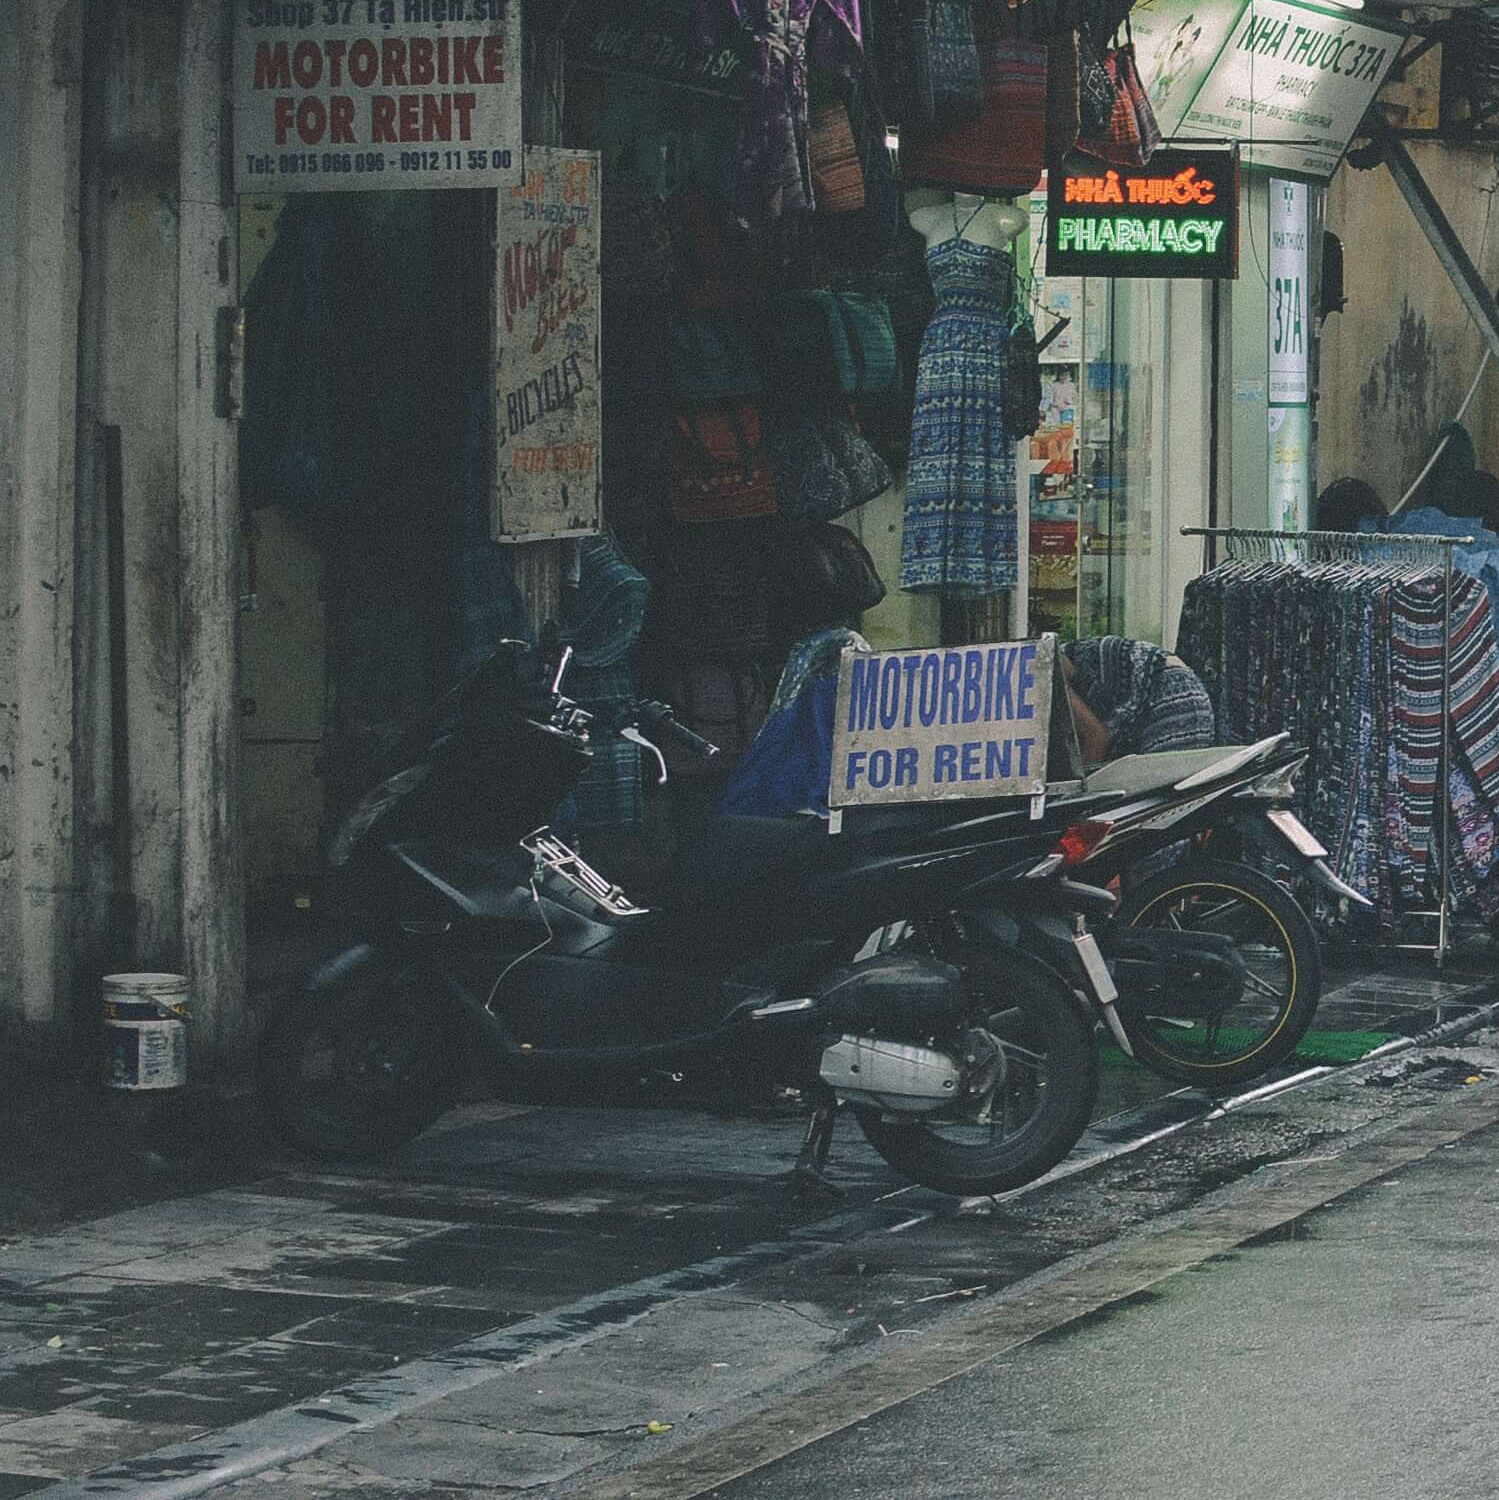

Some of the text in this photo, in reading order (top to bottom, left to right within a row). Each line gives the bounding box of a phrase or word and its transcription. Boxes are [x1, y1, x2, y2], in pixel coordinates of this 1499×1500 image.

[247, 0, 314, 29] Shop
[253, 35, 505, 90] MOTORBIKE
[1235, 12, 1387, 83] NHÀ THUỐC 37A
[275, 92, 477, 145] FOR RENT
[246, 153, 276, 175] Tel:
[279, 153, 318, 173] 0915
[322, 153, 351, 172] 066
[354, 152, 385, 171] 096
[401, 151, 439, 171] 0912
[445, 150, 462, 170] 11
[467, 150, 487, 169] 55
[491, 149, 512, 169] 00
[1064, 167, 1217, 205] NHÀ THUỐC
[1056, 217, 1225, 253] PHARMACY
[1274, 276, 1302, 355] 37A
[506, 350, 584, 437] BICYCLES
[848, 645, 1036, 732] MOTORBIKE
[846, 738, 1036, 790] FOR RENT
